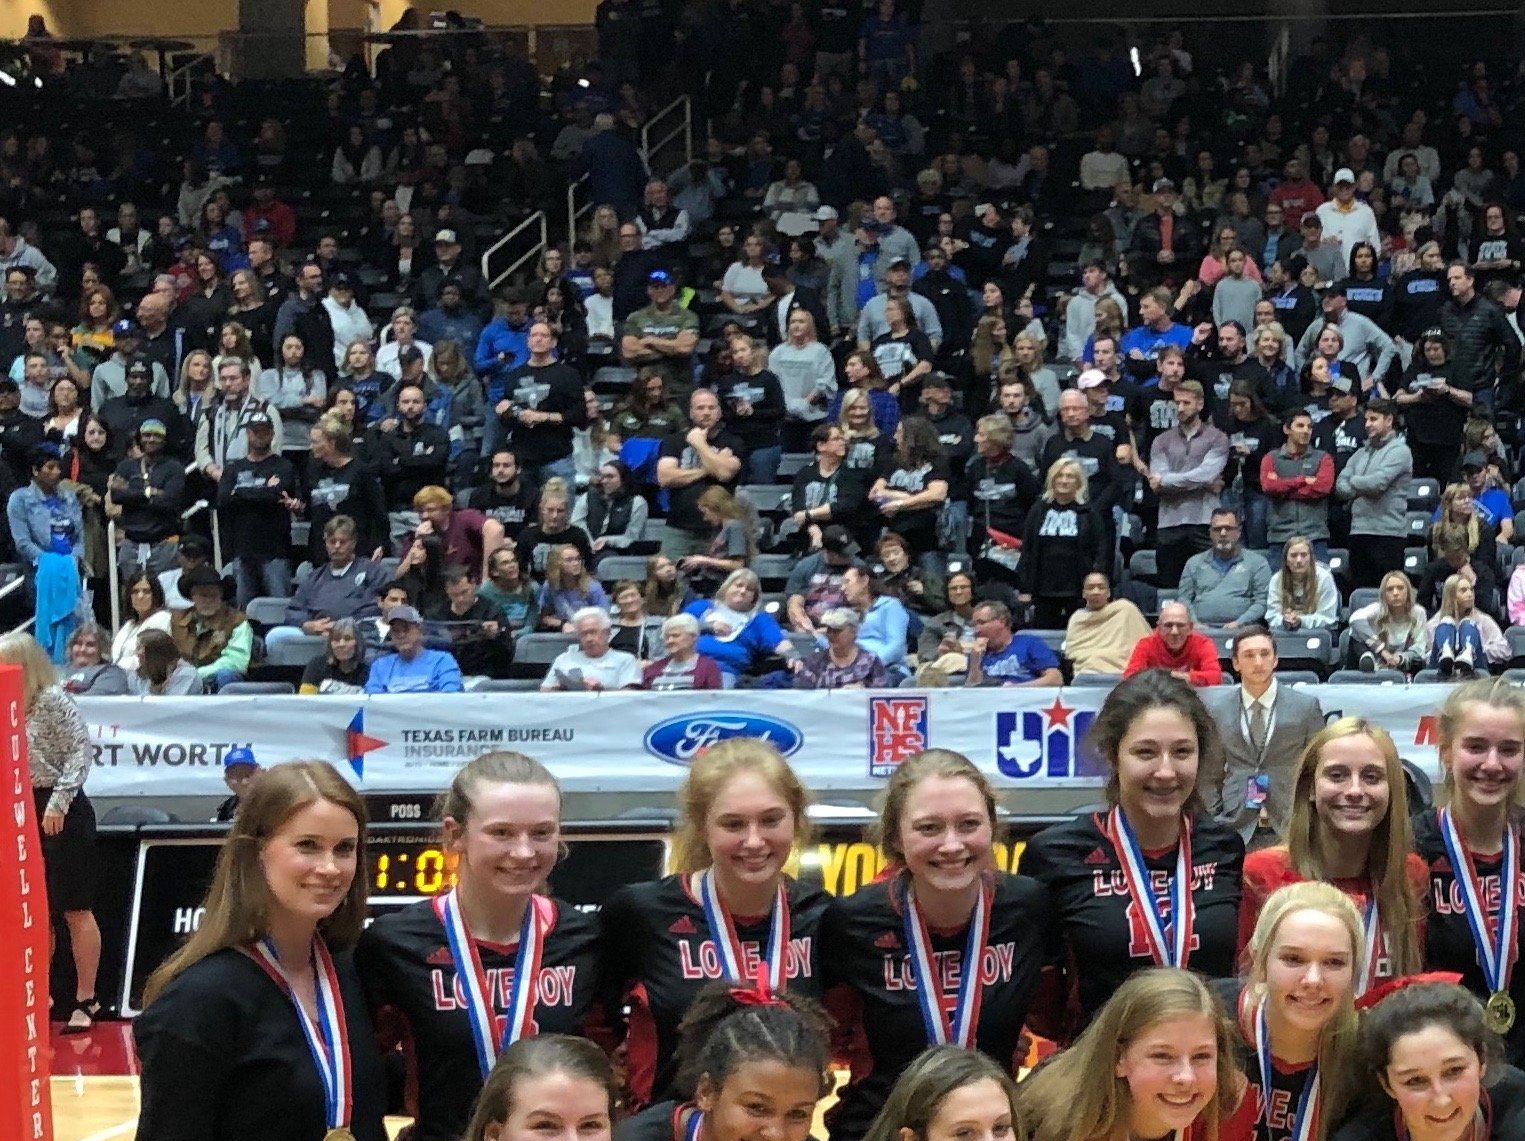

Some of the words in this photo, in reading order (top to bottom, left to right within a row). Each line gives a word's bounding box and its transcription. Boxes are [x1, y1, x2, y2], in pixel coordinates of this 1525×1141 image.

[401, 728, 454, 743] TEXAS
[458, 728, 504, 743] FARM
[508, 727, 575, 743] BUREAU
[131, 742, 252, 767] WORT
[391, 803, 421, 819] POSS
[9, 700, 33, 930] CULWELL
[23, 946, 44, 1140] CENTER
